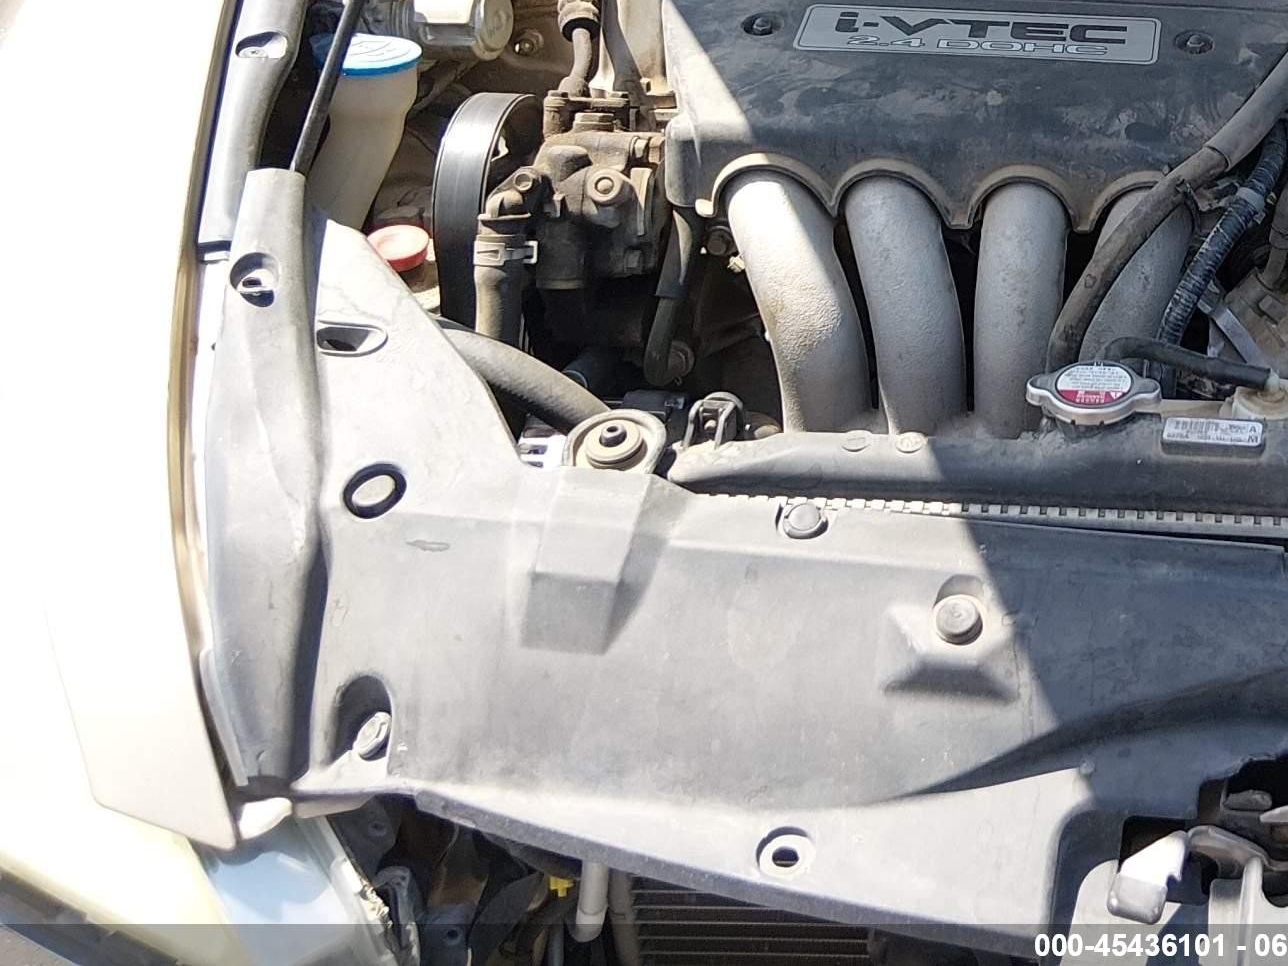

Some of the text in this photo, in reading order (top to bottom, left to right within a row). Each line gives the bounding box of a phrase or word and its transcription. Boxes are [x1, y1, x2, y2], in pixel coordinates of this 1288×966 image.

[834, 12, 1128, 45] i-VTEC
[846, 36, 1109, 55] 2.4 DOHC
